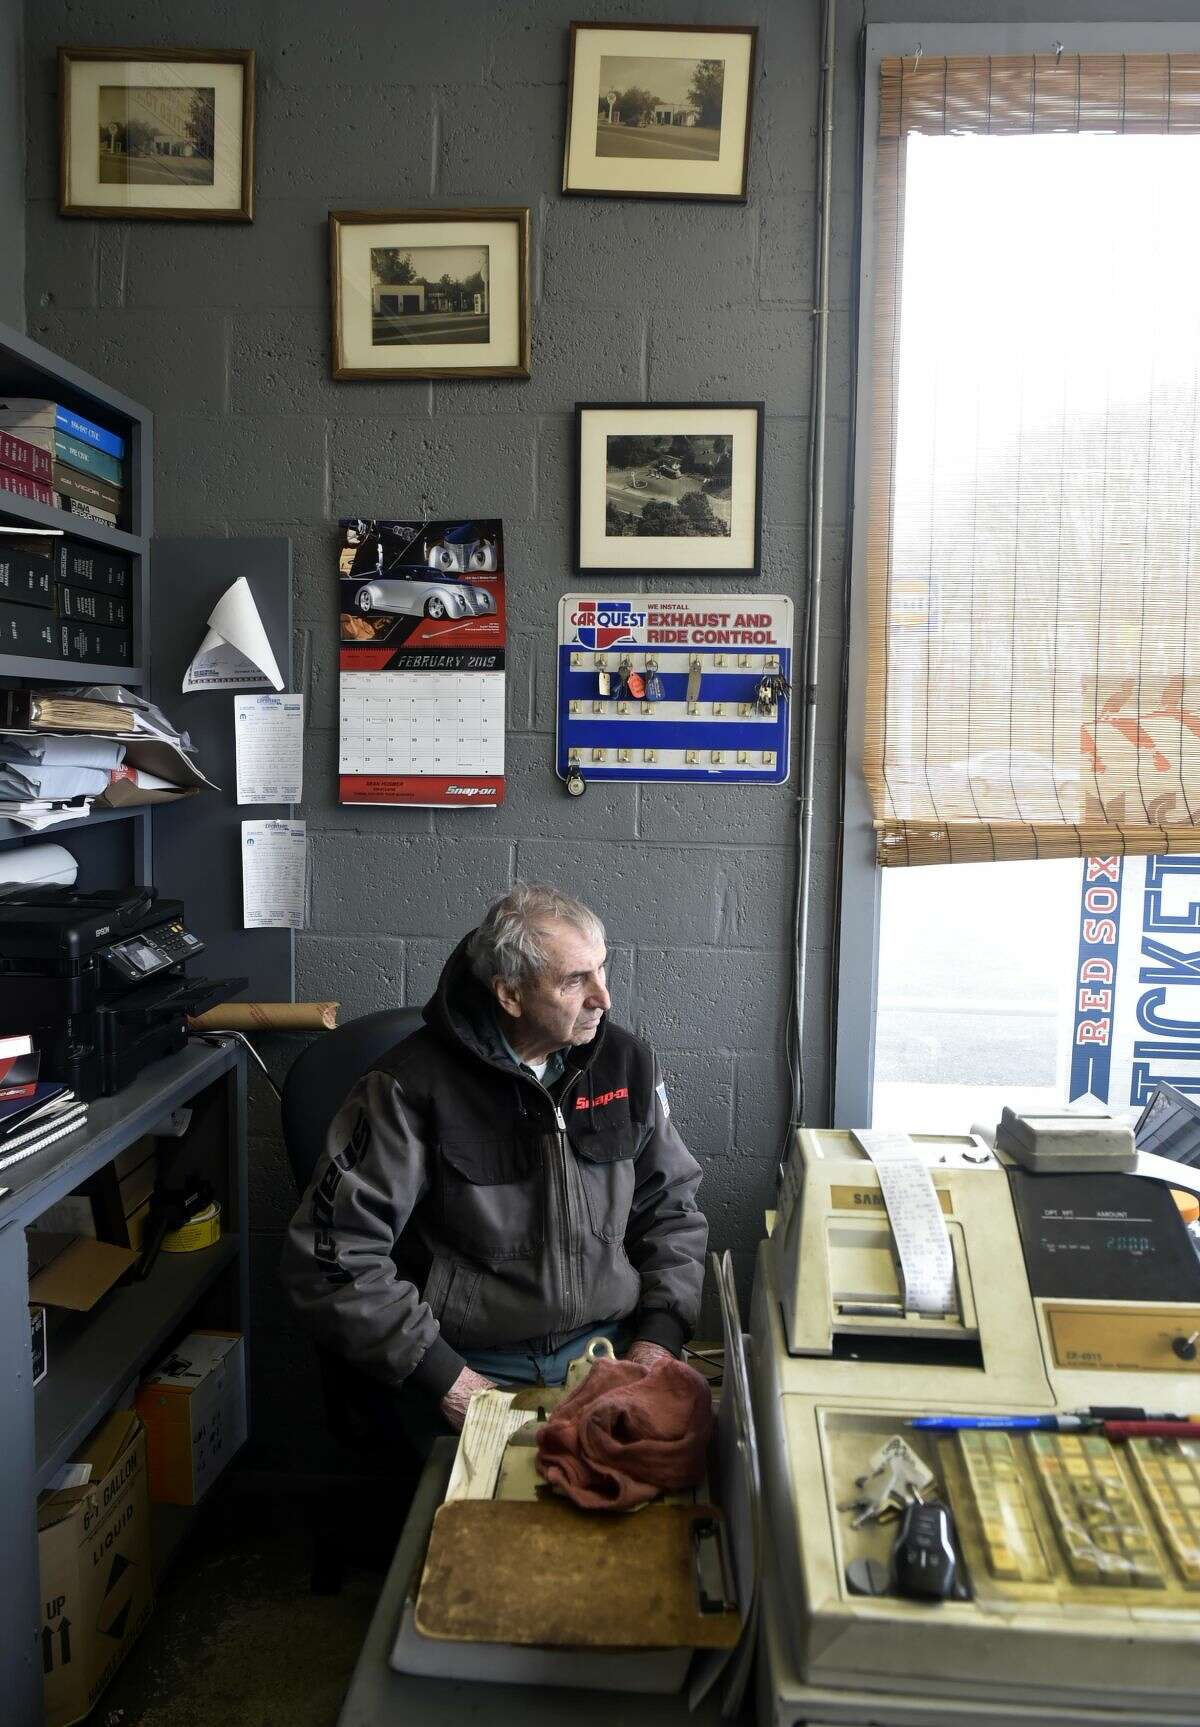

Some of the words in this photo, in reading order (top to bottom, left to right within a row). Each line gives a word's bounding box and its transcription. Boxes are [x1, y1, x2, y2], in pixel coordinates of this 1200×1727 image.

[647, 613, 731, 628] EXHAUST
[732, 614, 773, 629] AND
[647, 630, 688, 644] RIDE
[691, 630, 777, 645] CONTROL
[397, 655, 465, 669] FEBRUARY
[467, 656, 497, 669] 2019
[445, 785, 497, 797] Snap-on
[1083, 855, 1123, 945] SOX
[95, 925, 110, 938] EPSON
[1076, 957, 1115, 1046] RED
[103, 1450, 138, 1508] GALLON
[92, 1503, 135, 1566] LIQUID
[46, 1594, 66, 1620] UP
